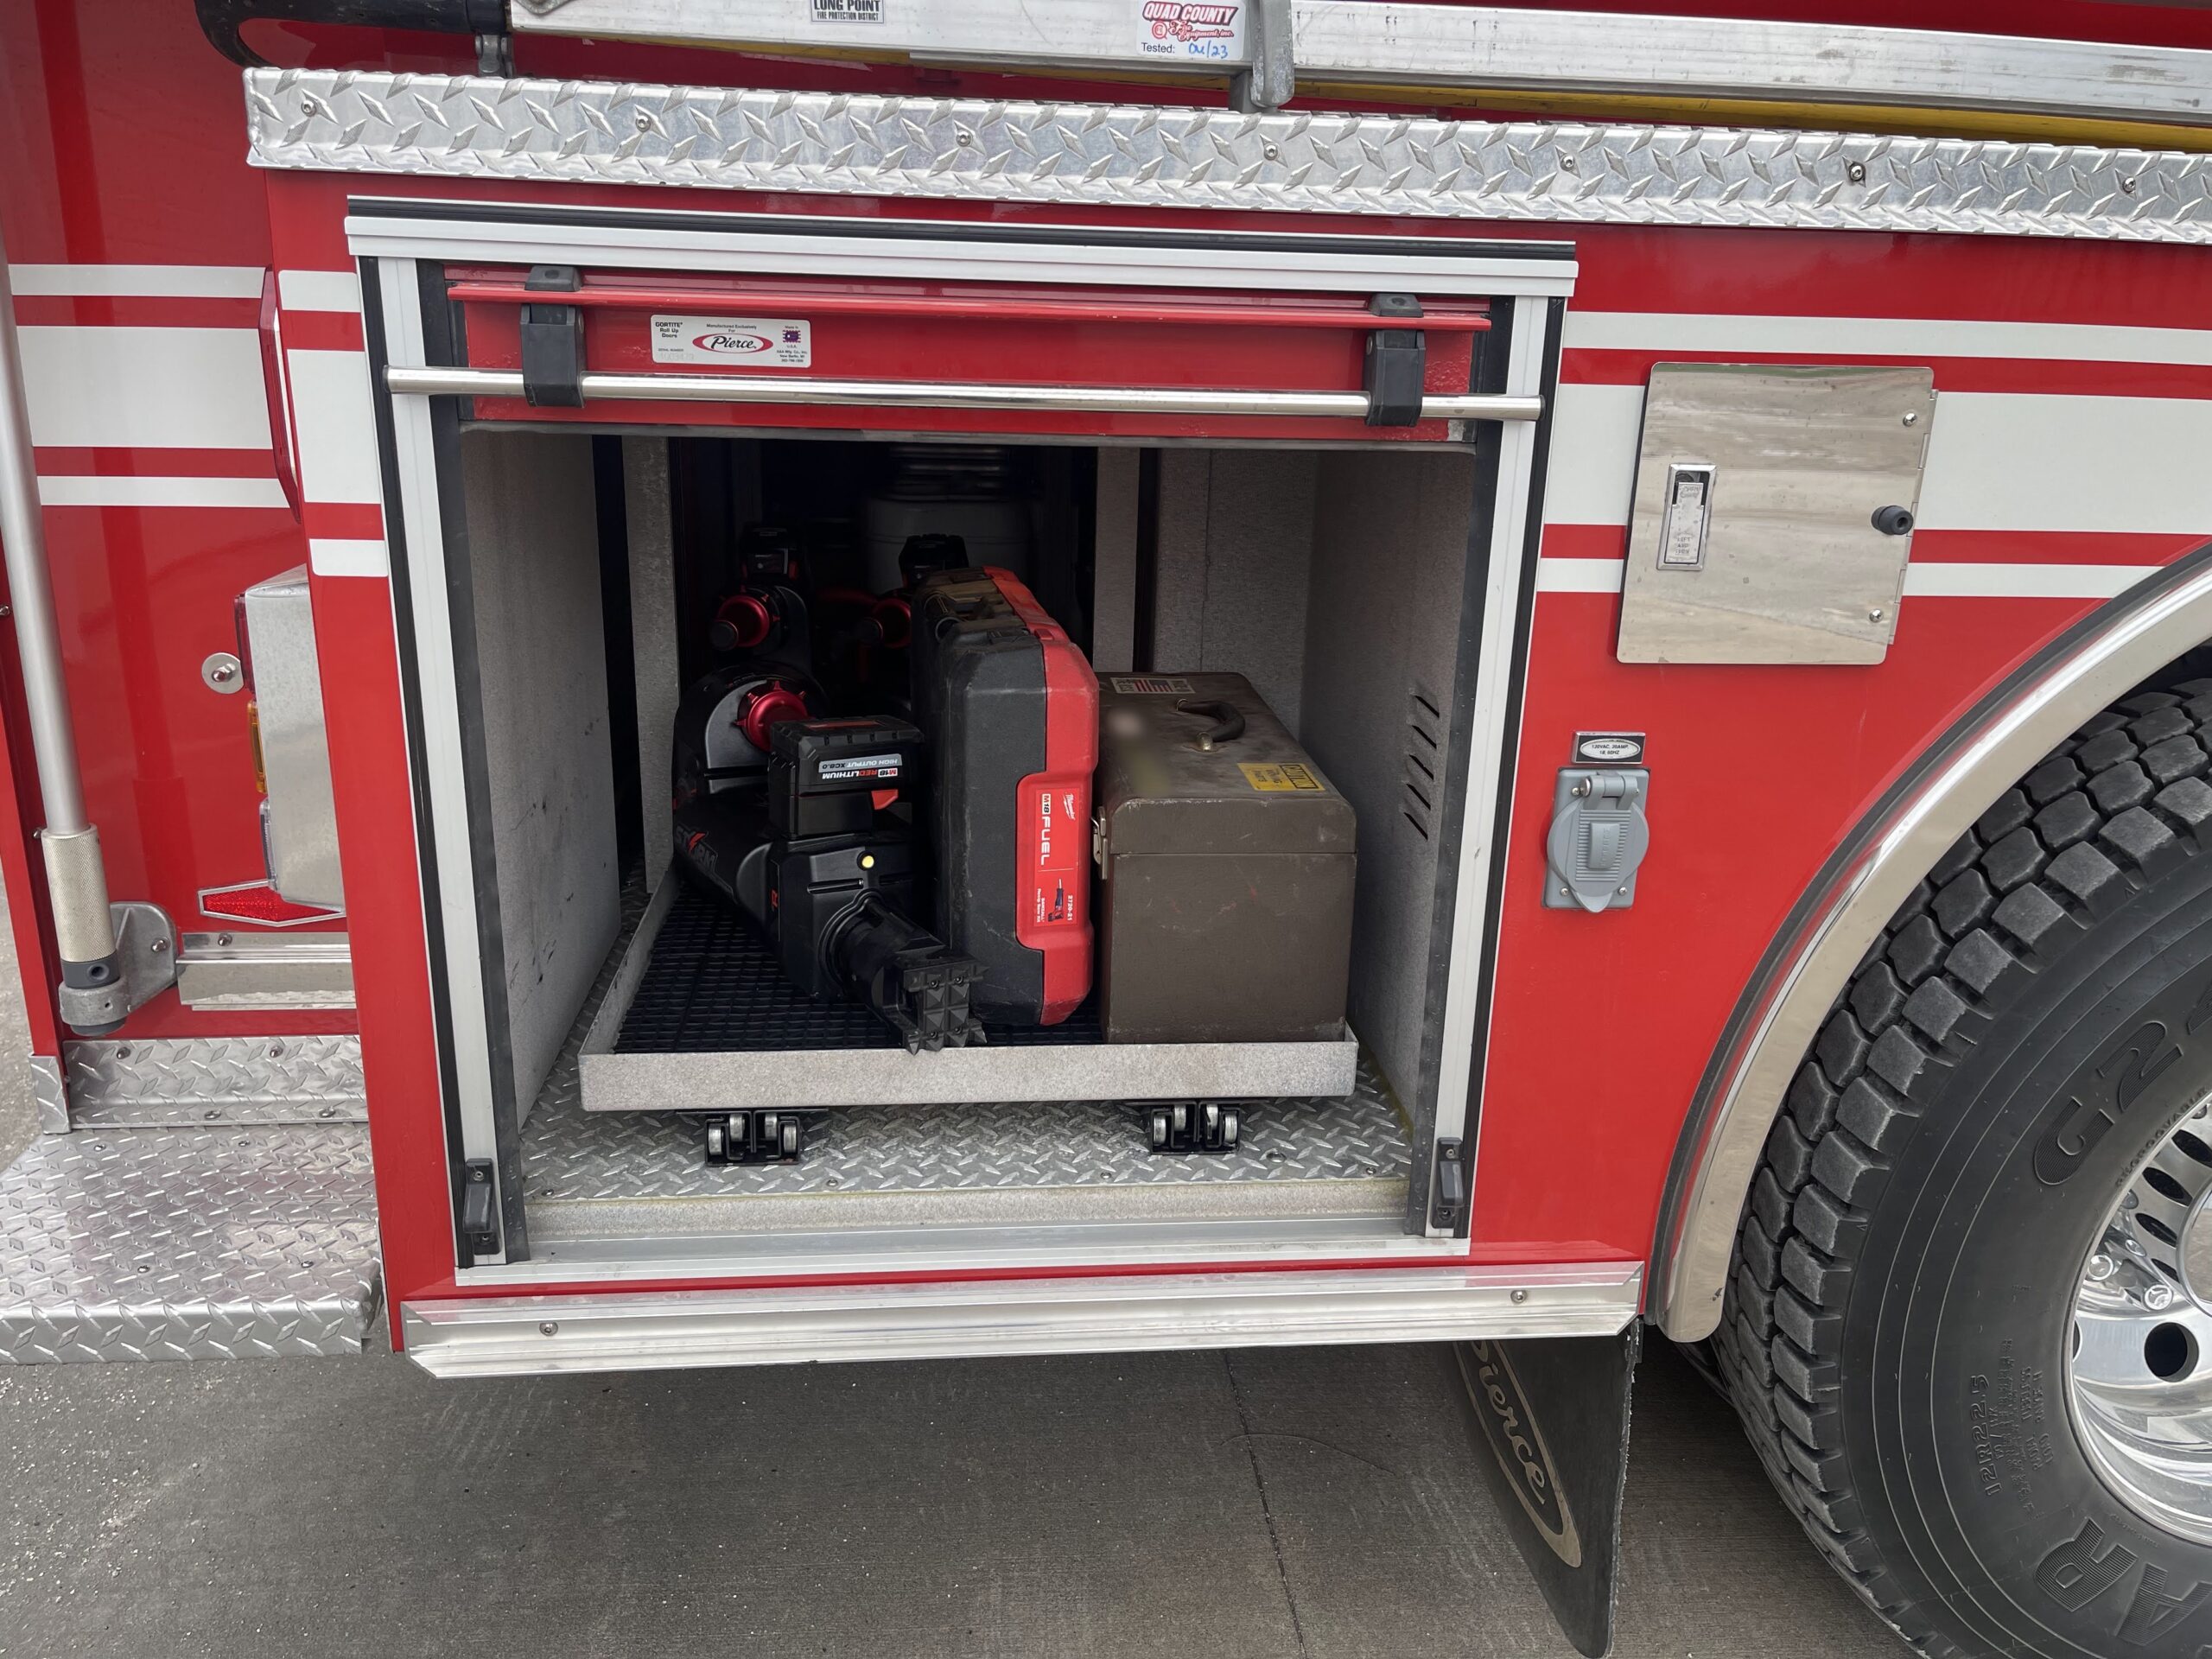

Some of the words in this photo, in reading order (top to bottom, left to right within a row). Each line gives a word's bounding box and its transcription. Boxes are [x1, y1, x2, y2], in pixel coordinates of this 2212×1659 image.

[847, 0, 880, 12] POINT
[828, 11, 856, 21] PROTECTION
[858, 12, 879, 21] DISTRICT
[1142, 1, 1182, 21] QUAD
[1180, 3, 1238, 26] COUNTY
[1141, 42, 1176, 54] Tested:
[710, 335, 758, 349] Pierce
[847, 760, 877, 768] OUTPUT
[822, 768, 878, 779] REDLITHIUM
[879, 768, 897, 777] M18
[1042, 794, 1051, 815] M18
[1040, 817, 1051, 866] FUEL
[1970, 1373, 2002, 1496] 12R22.5
